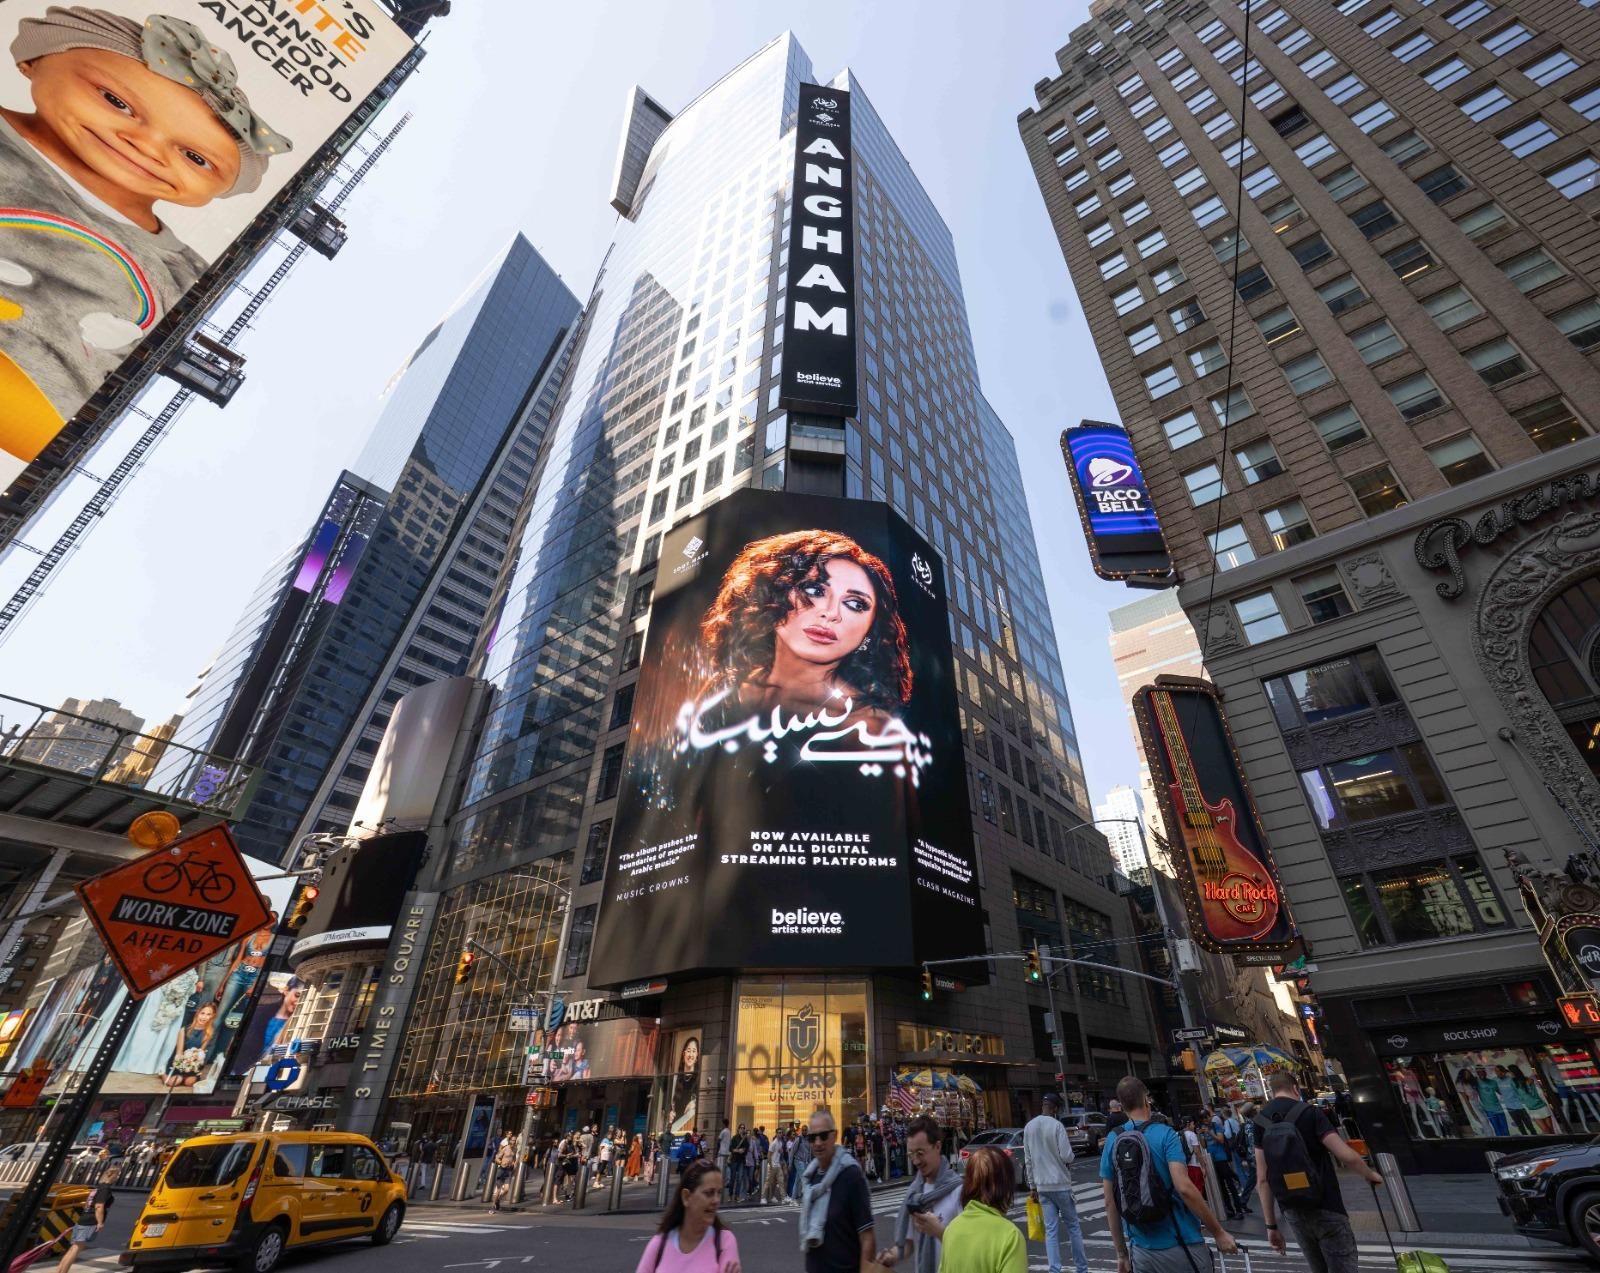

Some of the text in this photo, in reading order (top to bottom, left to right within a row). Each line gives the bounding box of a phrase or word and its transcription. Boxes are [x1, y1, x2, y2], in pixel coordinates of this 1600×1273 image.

[295, 0, 366, 62] ITE
[198, 1, 314, 96] ANCER
[228, 0, 352, 103] DHOOD
[794, 138, 847, 336] ANGHAM
[1091, 489, 1141, 502] TACO
[1098, 500, 1147, 513] BELL
[1415, 473, 1600, 602] Param
[636, 846, 657, 858] album
[659, 839, 683, 851] pushes
[686, 833, 698, 842] the
[750, 831, 870, 843] NOW AVAILABLE
[619, 844, 695, 871] boundaries of modern
[720, 854, 897, 867] STREAMING PLATFORMS
[752, 844, 868, 854] ON ALL DIGITAL
[925, 842, 947, 858] hypnotic
[630, 866, 653, 877] Arabic
[616, 875, 690, 902] MUSIC CROWNS
[917, 877, 976, 906] CLASH MAGAZINE
[1204, 881, 1278, 905] Hard Rock
[118, 898, 235, 935] WORK ZONE
[771, 907, 842, 925] believe
[771, 925, 842, 934] artist services
[122, 931, 203, 954] AHEAD
[355, 906, 424, 1097] 3 TIMES SQUARE
[563, 998, 605, 1022] AT&T
[1443, 1028, 1498, 1041] ROCK SHOP
[767, 1072, 837, 1090] TOURO
[275, 1096, 334, 1109] CHASE
[769, 1089, 834, 1102] UNIVERSITY
